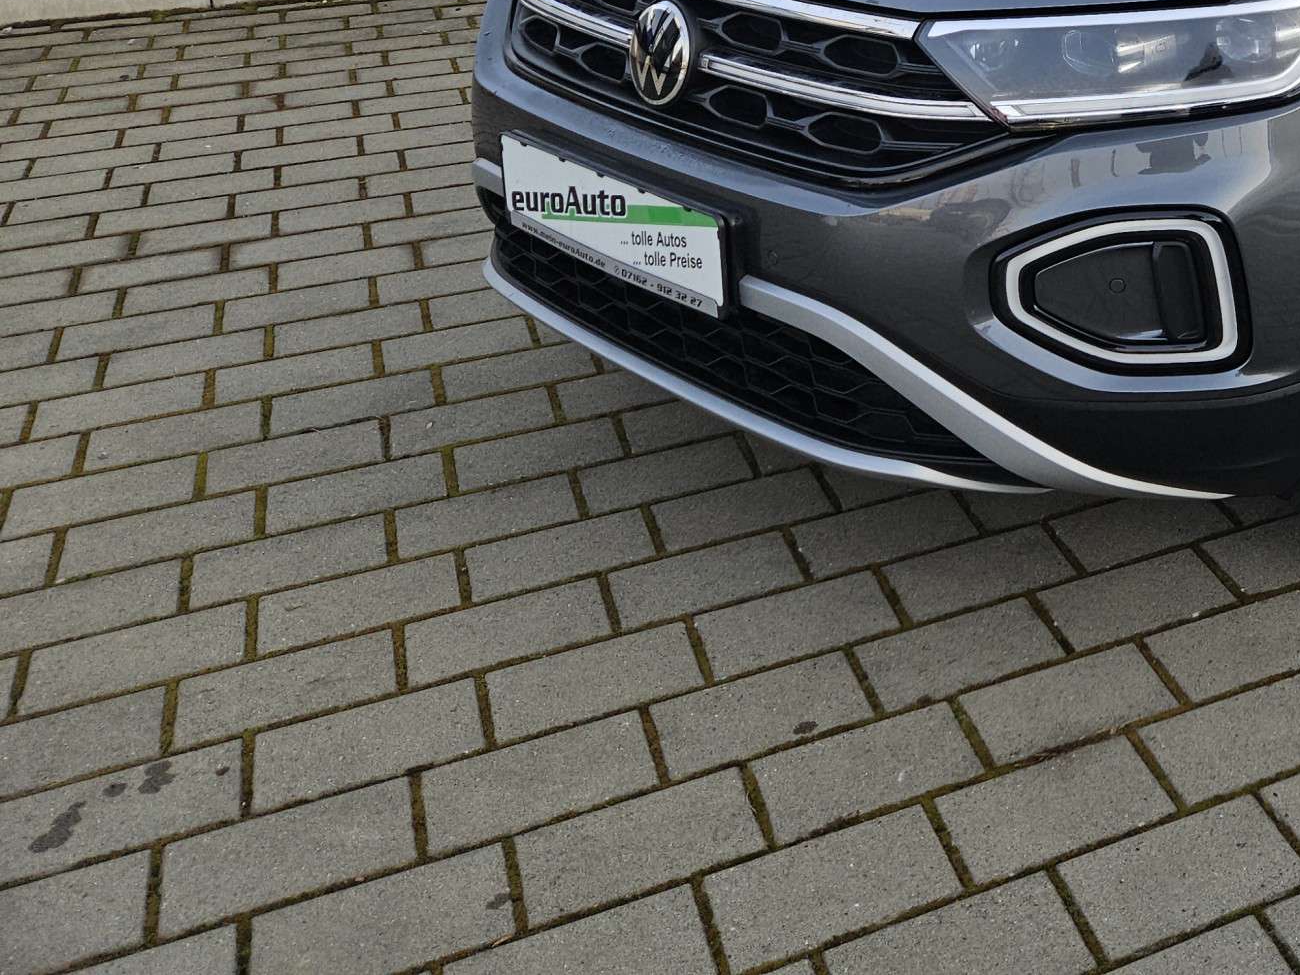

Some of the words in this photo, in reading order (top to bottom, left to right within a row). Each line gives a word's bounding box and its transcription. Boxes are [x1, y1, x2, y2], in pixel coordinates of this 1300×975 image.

[511, 185, 627, 217] euroAuto
[631, 231, 653, 247] tolle
[656, 231, 687, 248] Autos
[644, 252, 667, 266] tolle
[669, 254, 703, 269] Preise
